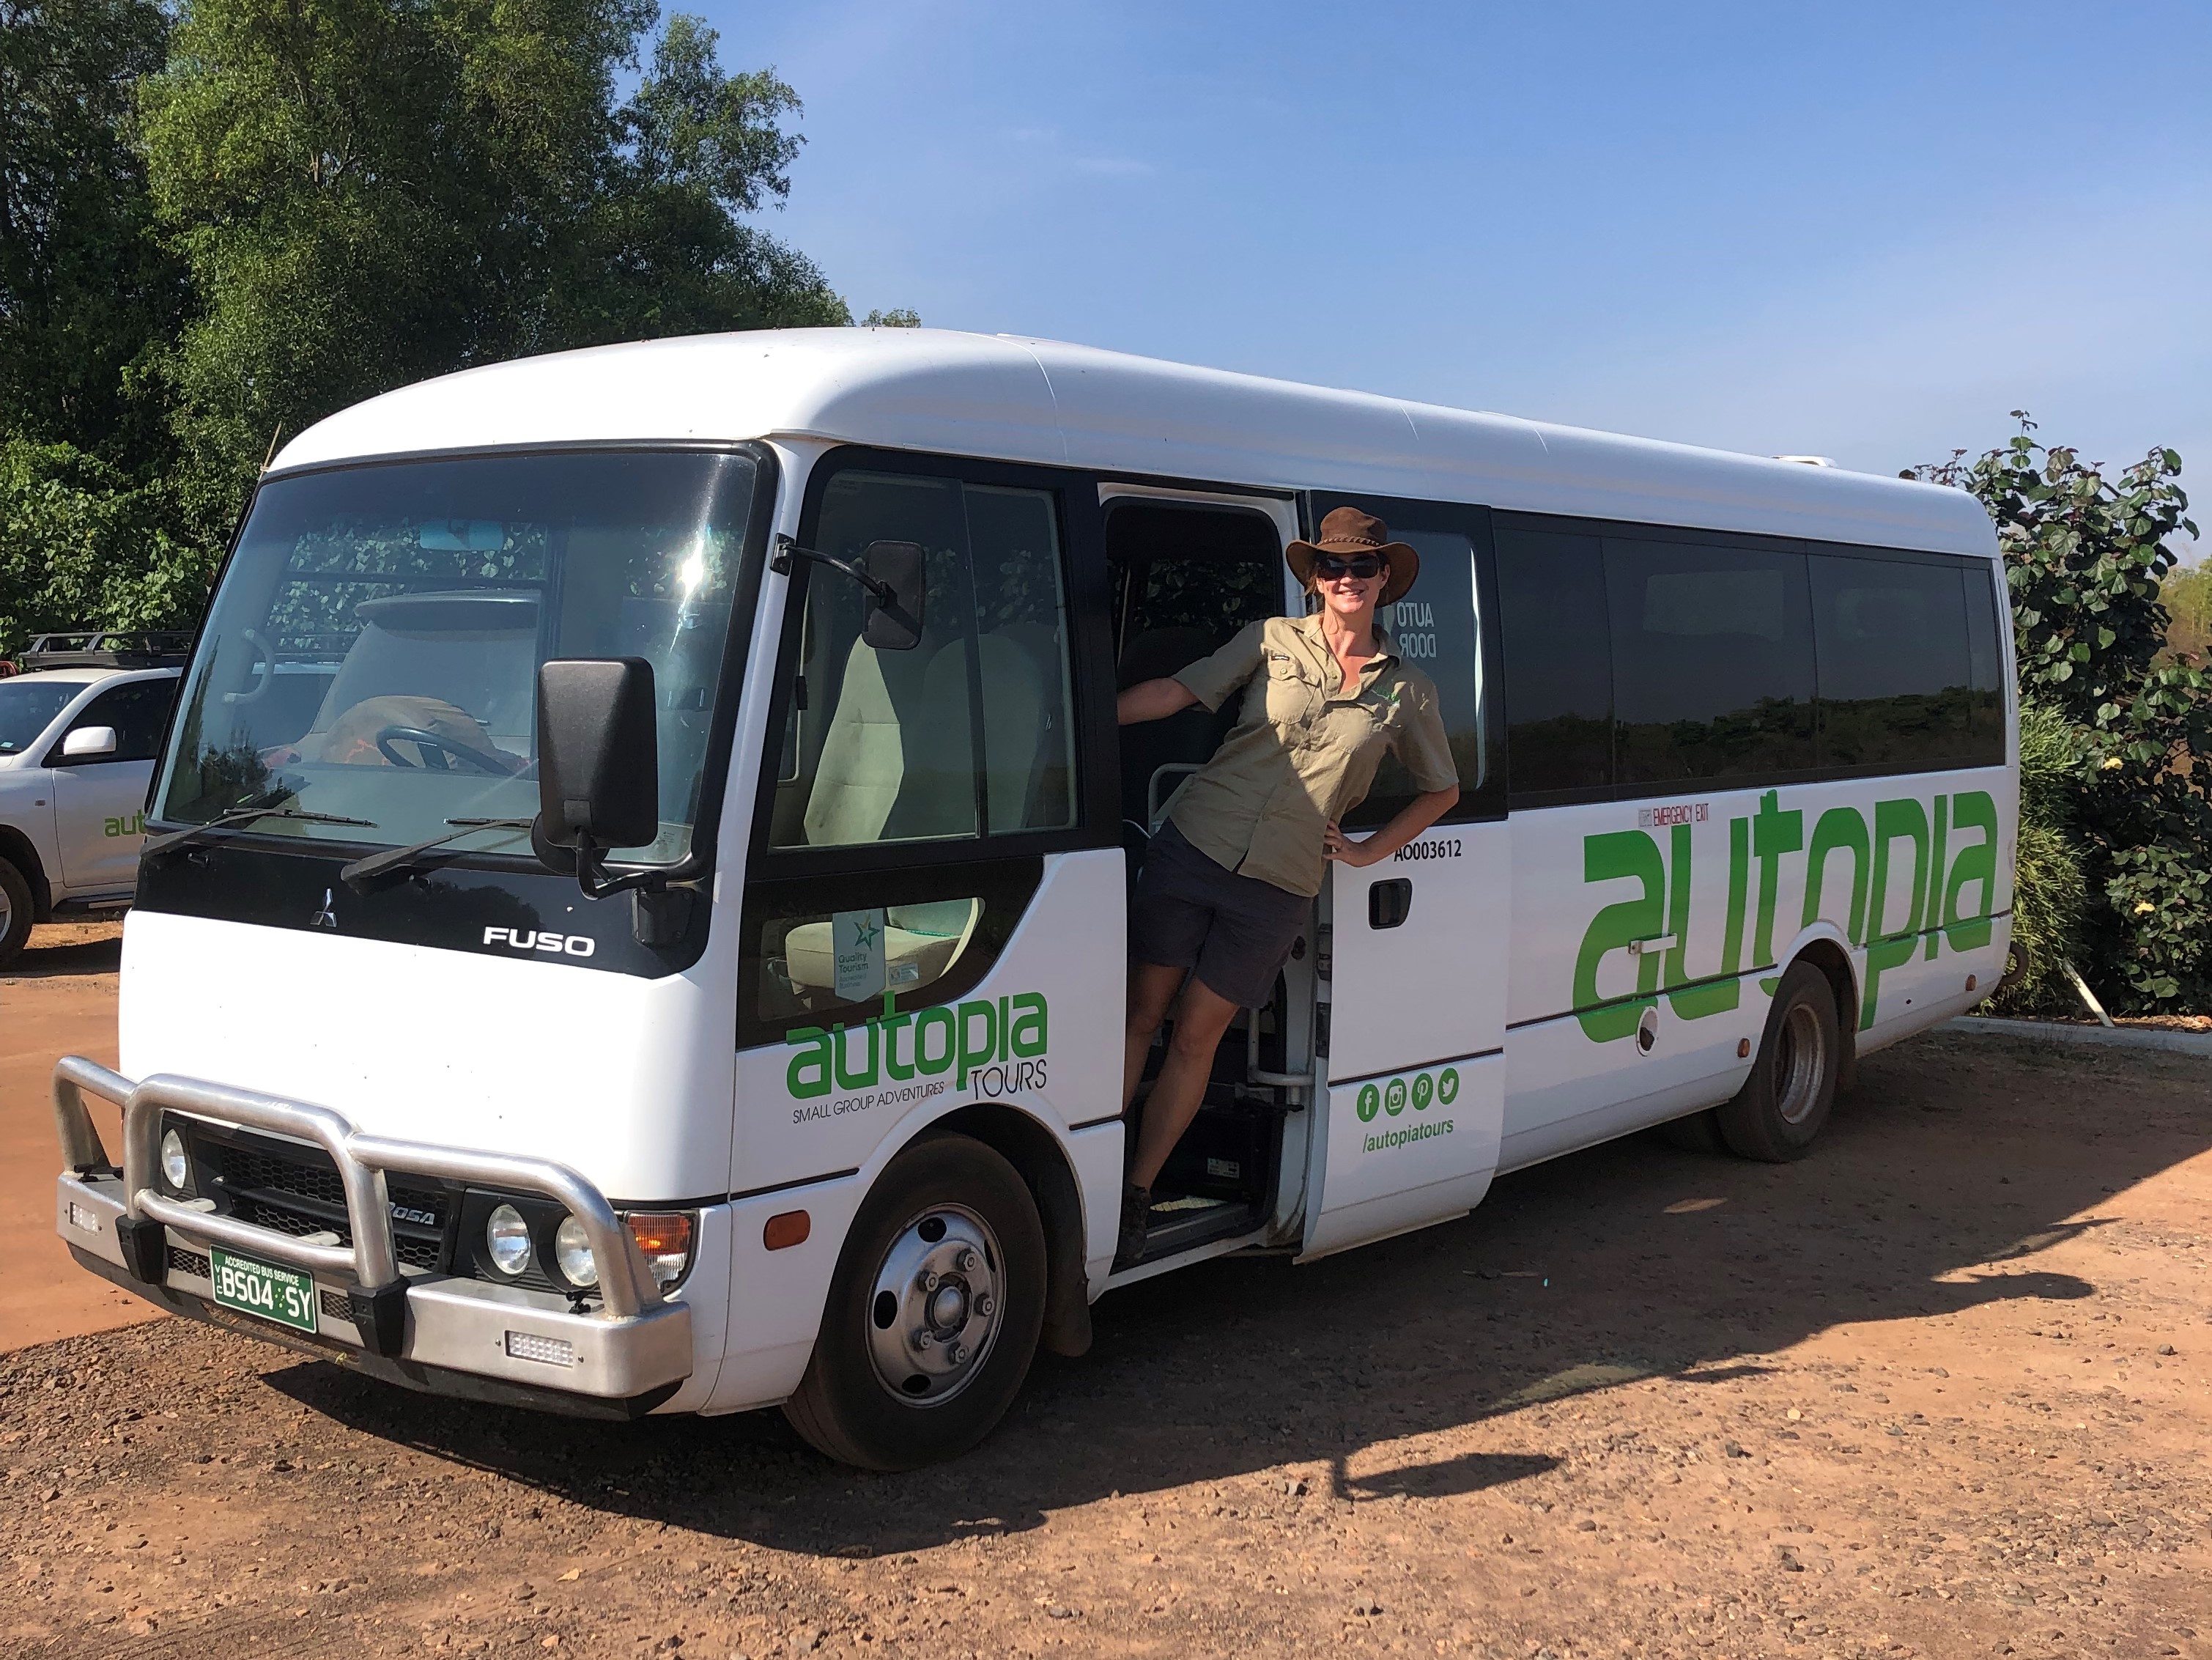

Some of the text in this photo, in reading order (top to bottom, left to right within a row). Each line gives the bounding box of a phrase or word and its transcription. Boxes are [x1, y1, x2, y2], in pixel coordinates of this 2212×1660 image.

[1653, 803, 1709, 826] EMERGENCY EXIT
[1394, 838, 1462, 862] AO003612
[1572, 789, 1998, 1043] autopia
[483, 926, 595, 957] FUSO
[838, 952, 868, 963] Quality
[838, 962, 869, 973] Tourism
[786, 991, 1048, 1099] autopia
[971, 1059, 1048, 1100] TOURS
[793, 1081, 945, 1124] SMALL GROUP ADVENTURES
[1362, 1119, 1454, 1154] /autopiatours
[224, 1255, 300, 1287] ACCREDITED BUS SERVICE
[285, 1285, 311, 1321] SY
